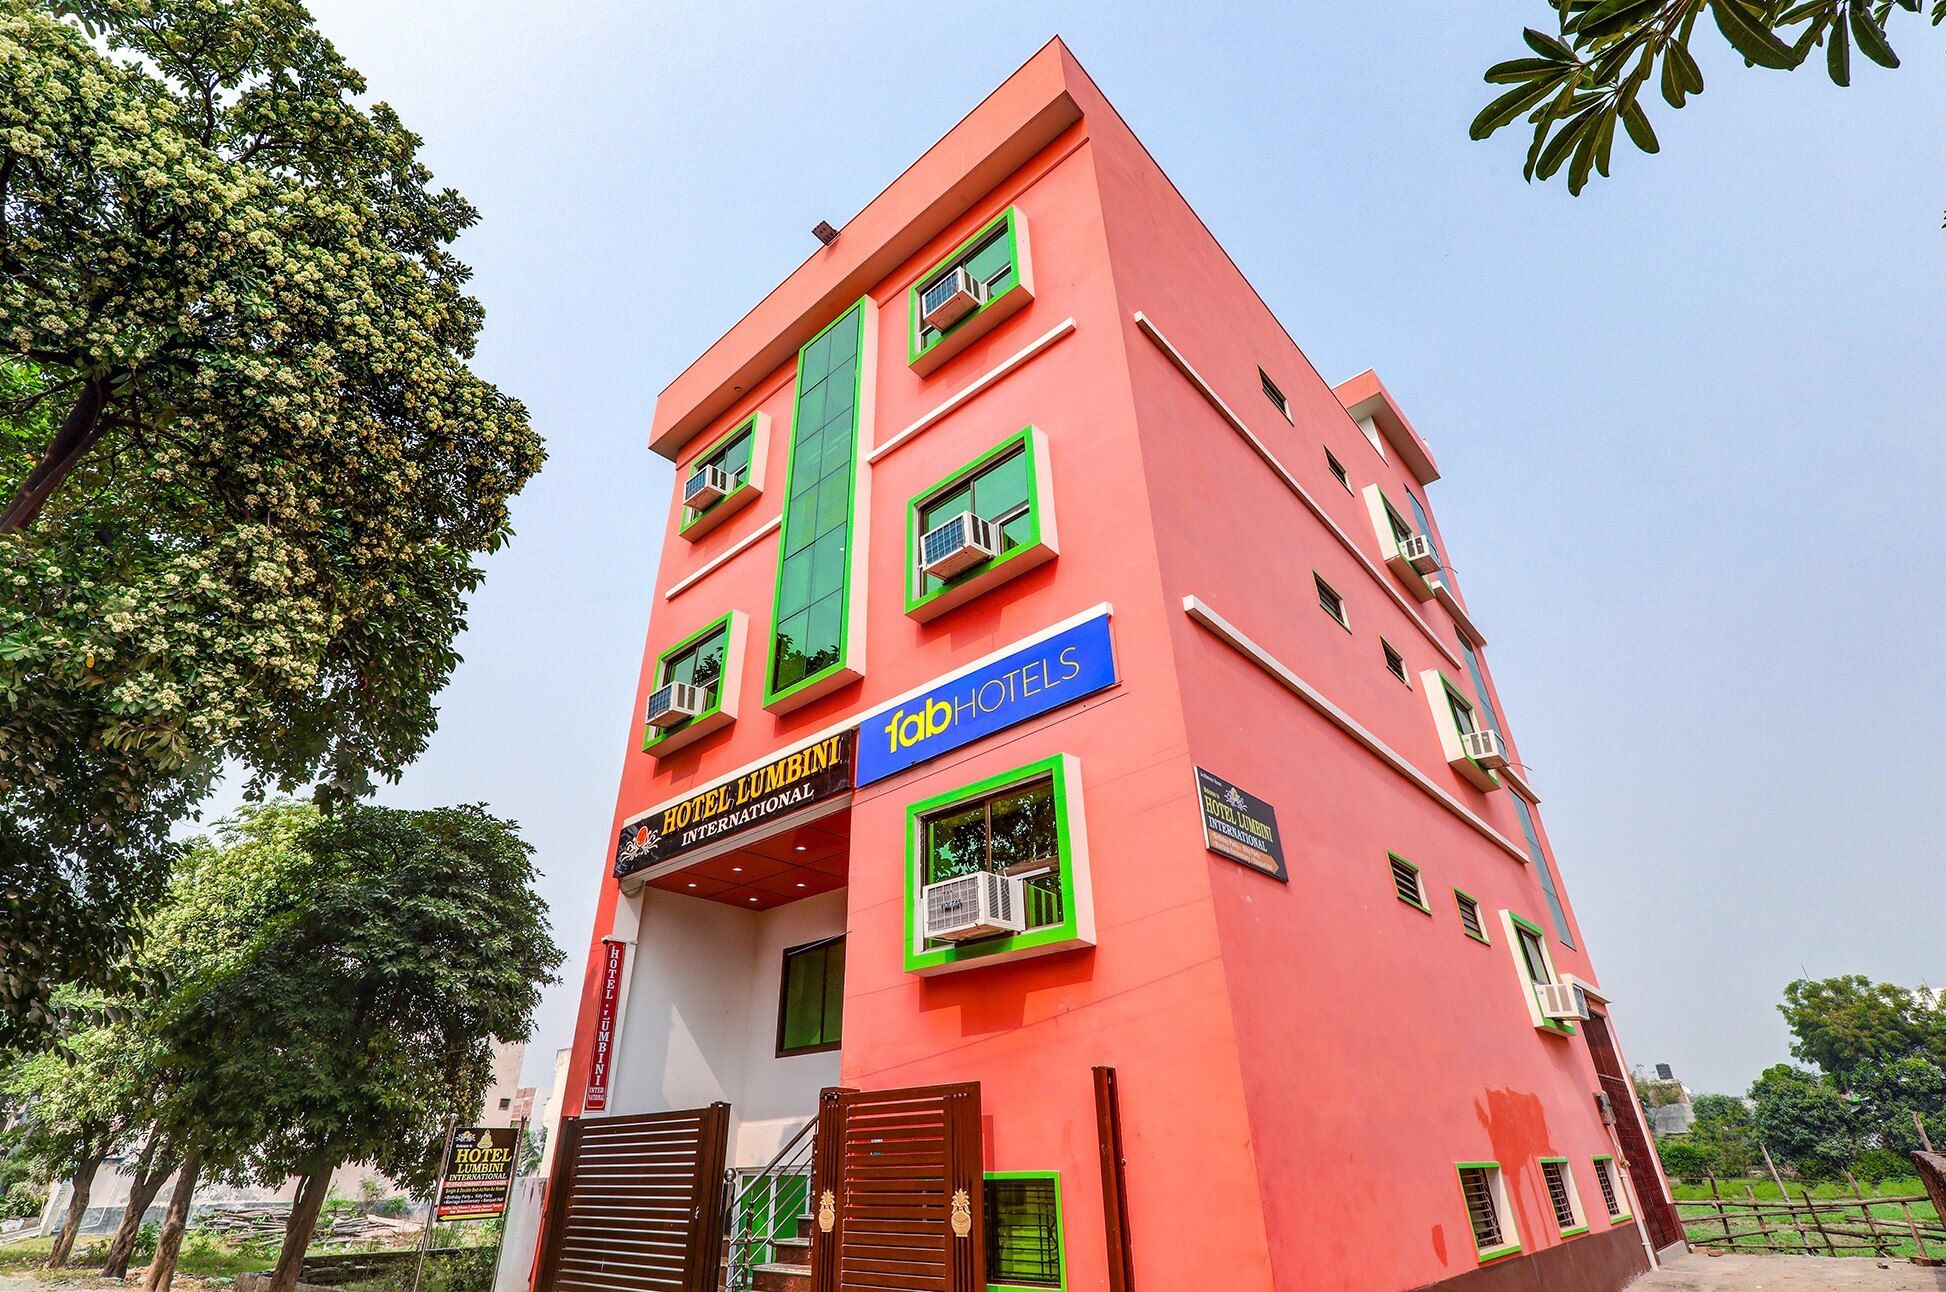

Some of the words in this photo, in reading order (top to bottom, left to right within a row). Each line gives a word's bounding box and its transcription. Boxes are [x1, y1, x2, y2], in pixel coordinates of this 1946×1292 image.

[661, 785, 731, 838] HOTEL
[736, 735, 841, 804] LUMBINI
[681, 783, 815, 847] INTERNATIONAL
[1204, 795, 1237, 824] HOTEL
[1237, 811, 1273, 843] LUMBINI
[1208, 816, 1268, 852] INTERNATIONAL
[605, 945, 619, 999] HOTEL
[455, 1148, 512, 1162] HOTEL
[457, 1163, 504, 1173] LUMBINI
[449, 1173, 508, 1181] INTERNATIONAL
